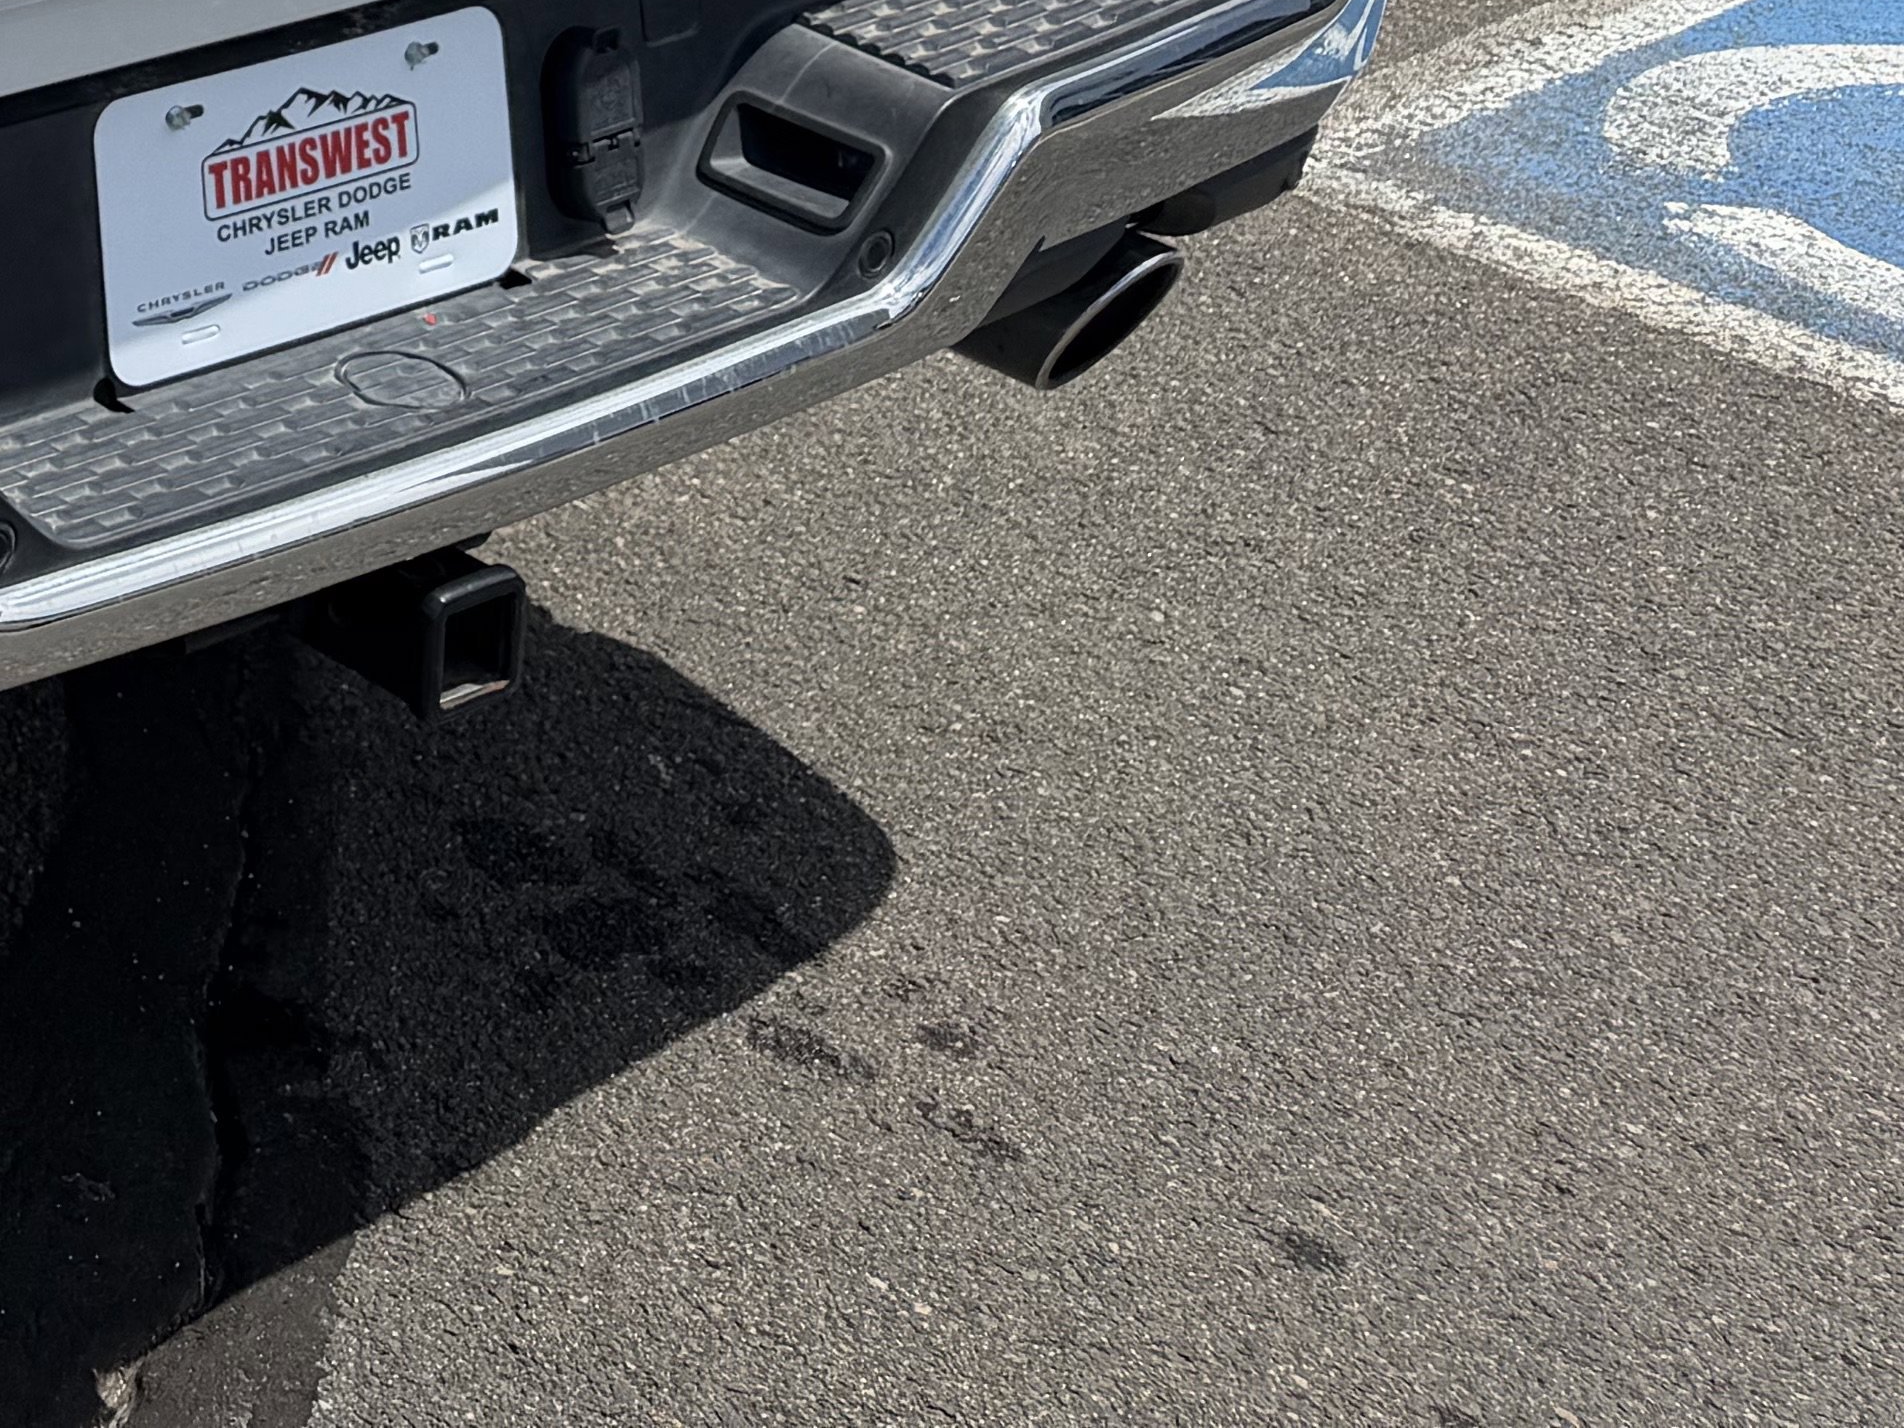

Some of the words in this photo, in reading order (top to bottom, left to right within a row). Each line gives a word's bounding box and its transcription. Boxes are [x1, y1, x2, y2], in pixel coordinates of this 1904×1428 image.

[208, 110, 411, 209] TRANSWEST
[216, 196, 332, 243] CHRYSLER
[338, 172, 412, 216] DODGE
[432, 207, 500, 242] RAM
[264, 225, 318, 256] JEEP
[323, 210, 371, 243] RAM
[345, 234, 401, 271] Jeep
[136, 280, 227, 314] CHRYSLER
